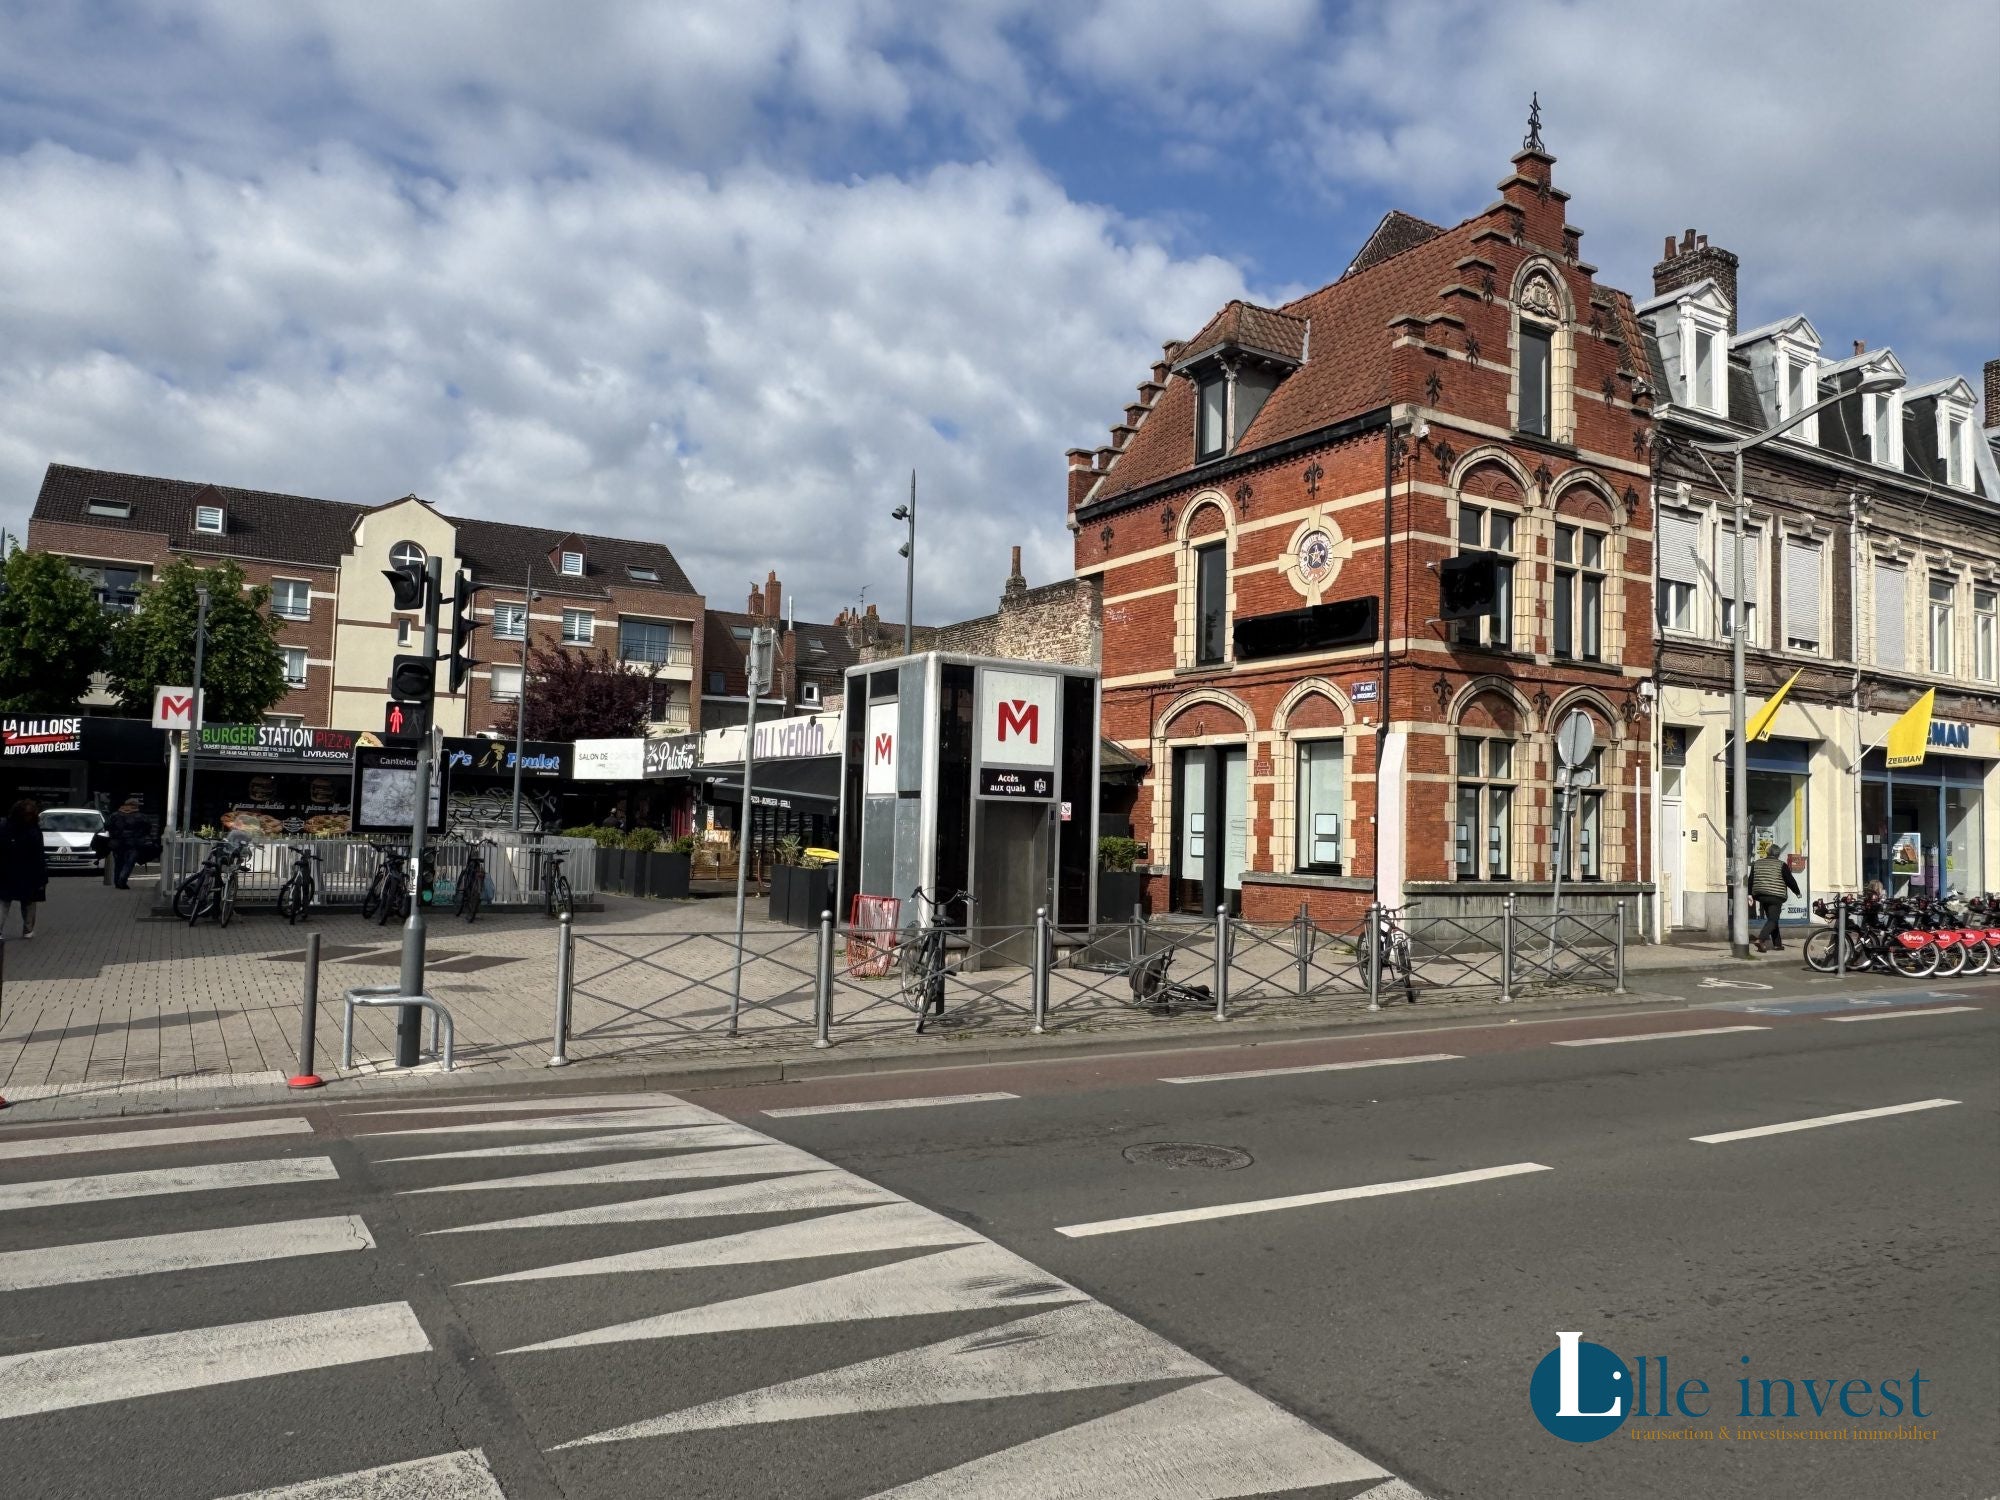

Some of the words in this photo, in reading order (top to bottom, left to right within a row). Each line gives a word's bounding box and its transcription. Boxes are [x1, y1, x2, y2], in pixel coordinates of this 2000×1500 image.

[2, 719, 17, 732] LA
[19, 718, 82, 737] LILLOISE
[997, 699, 1039, 744] M
[202, 726, 256, 746] BURGER
[258, 727, 313, 748] STATION
[315, 731, 352, 749] PIZZA
[755, 724, 824, 758] OLLYFOOD
[3, 743, 54, 755] AUTO/MOTO
[54, 741, 81, 752] ÉCOLE
[302, 750, 349, 759] LIVRAISON
[875, 733, 892, 766] M
[449, 750, 473, 769] y's
[506, 752, 560, 770] Poulet
[578, 753, 599, 761] SALON
[600, 752, 609, 761] DE
[1887, 755, 1922, 765] ZEEMAN
[997, 773, 1019, 783] Accès
[990, 784, 1004, 792] aux
[1006, 784, 1026, 794] quais
